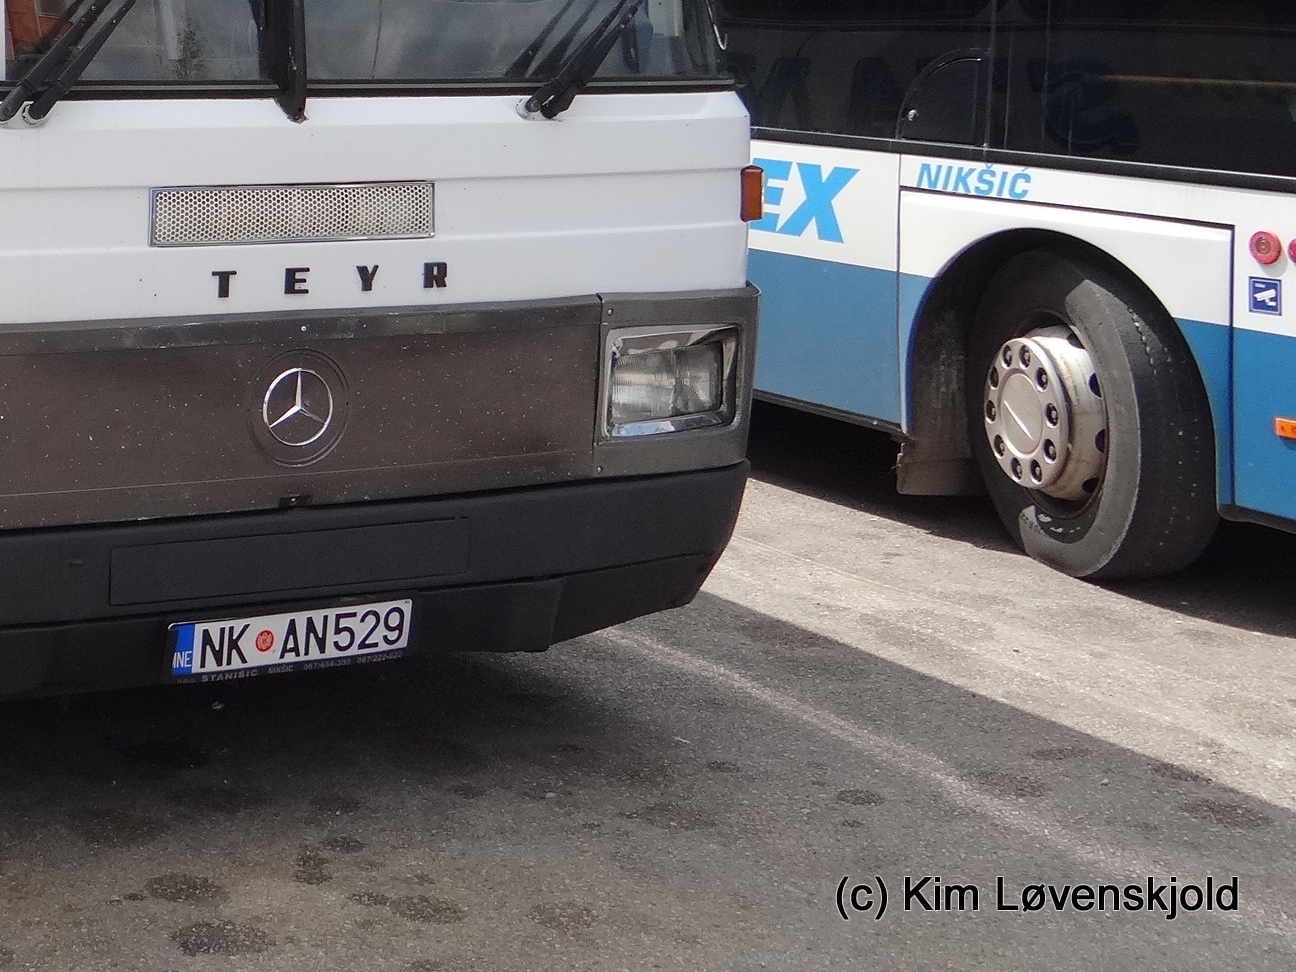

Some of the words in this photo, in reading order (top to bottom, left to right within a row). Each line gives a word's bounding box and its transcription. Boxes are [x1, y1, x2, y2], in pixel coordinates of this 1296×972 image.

[915, 162, 1032, 200] NIKŠIĆ
[211, 261, 448, 298] TEYR
[200, 624, 250, 668] NK
[279, 606, 405, 659] AN529
